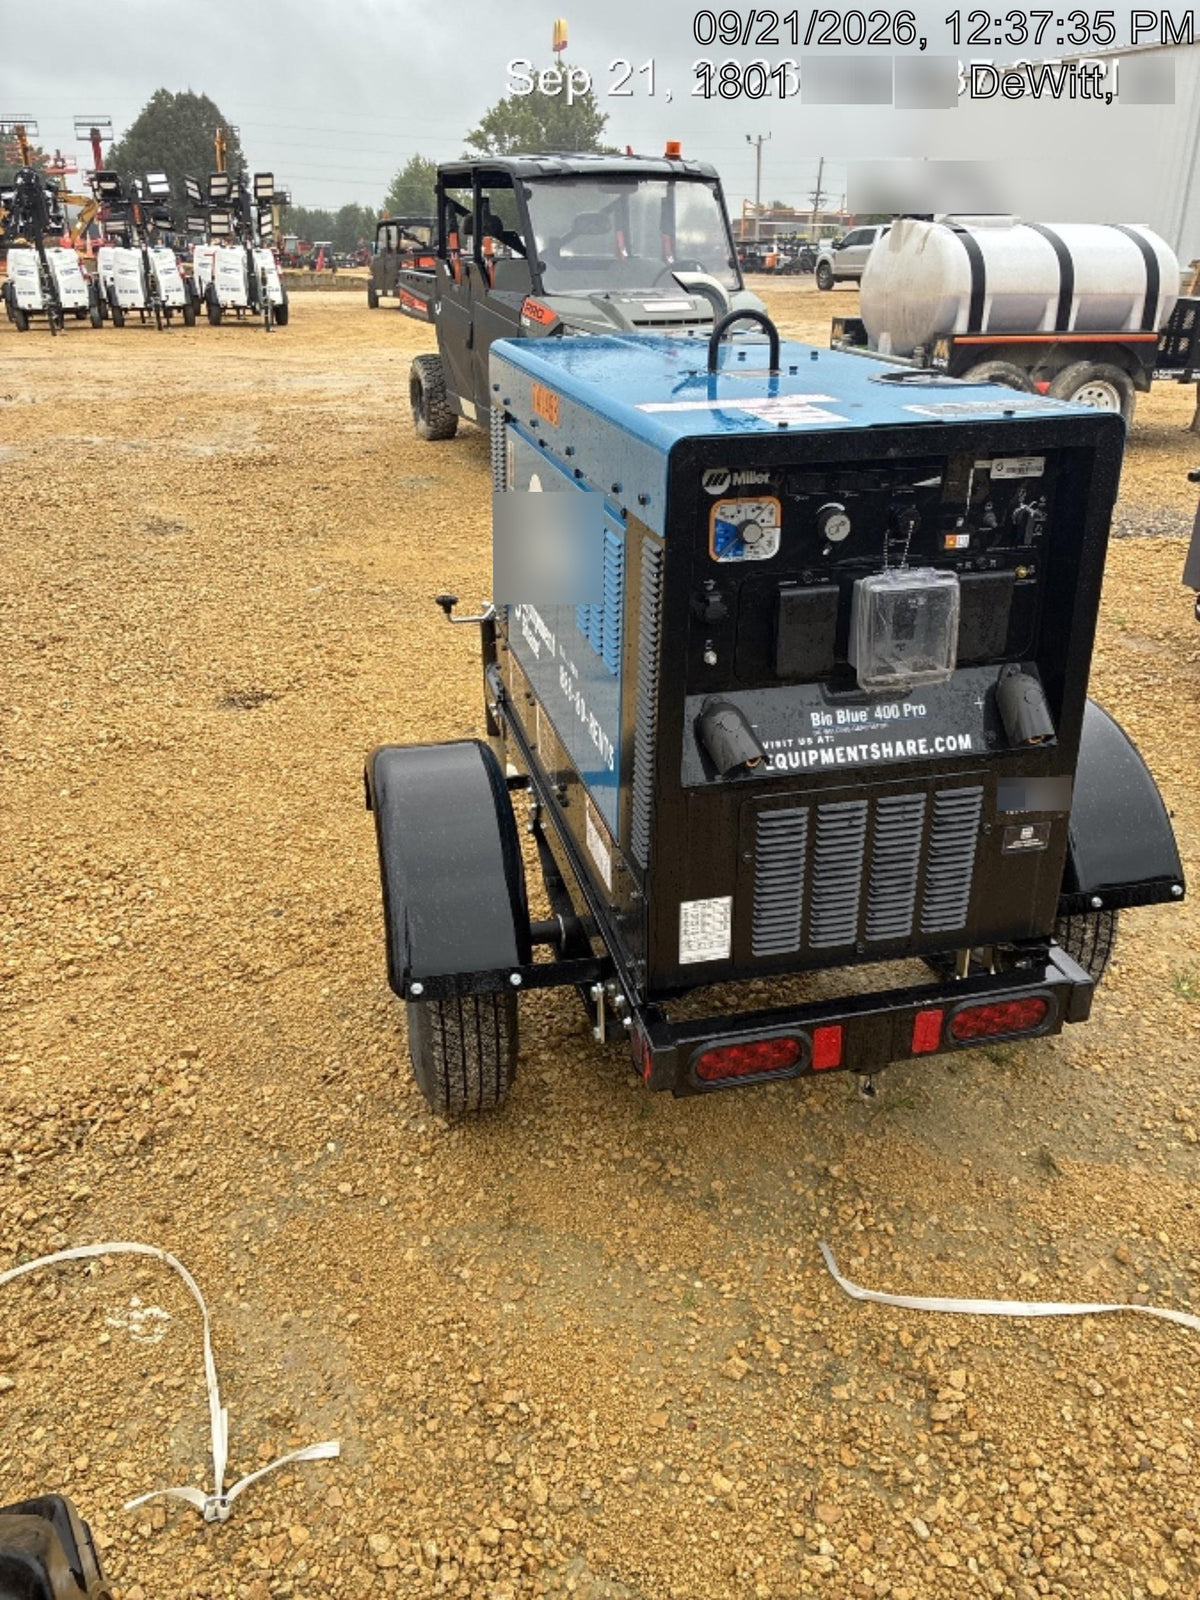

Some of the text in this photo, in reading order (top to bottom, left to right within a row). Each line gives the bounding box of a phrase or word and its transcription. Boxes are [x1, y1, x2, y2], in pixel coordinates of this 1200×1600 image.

[731, 470, 771, 486] Miller
[836, 707, 869, 724] Blue
[874, 704, 900, 720] 400
[903, 702, 927, 717] Pro
[762, 734, 836, 750] VISIT US AT:
